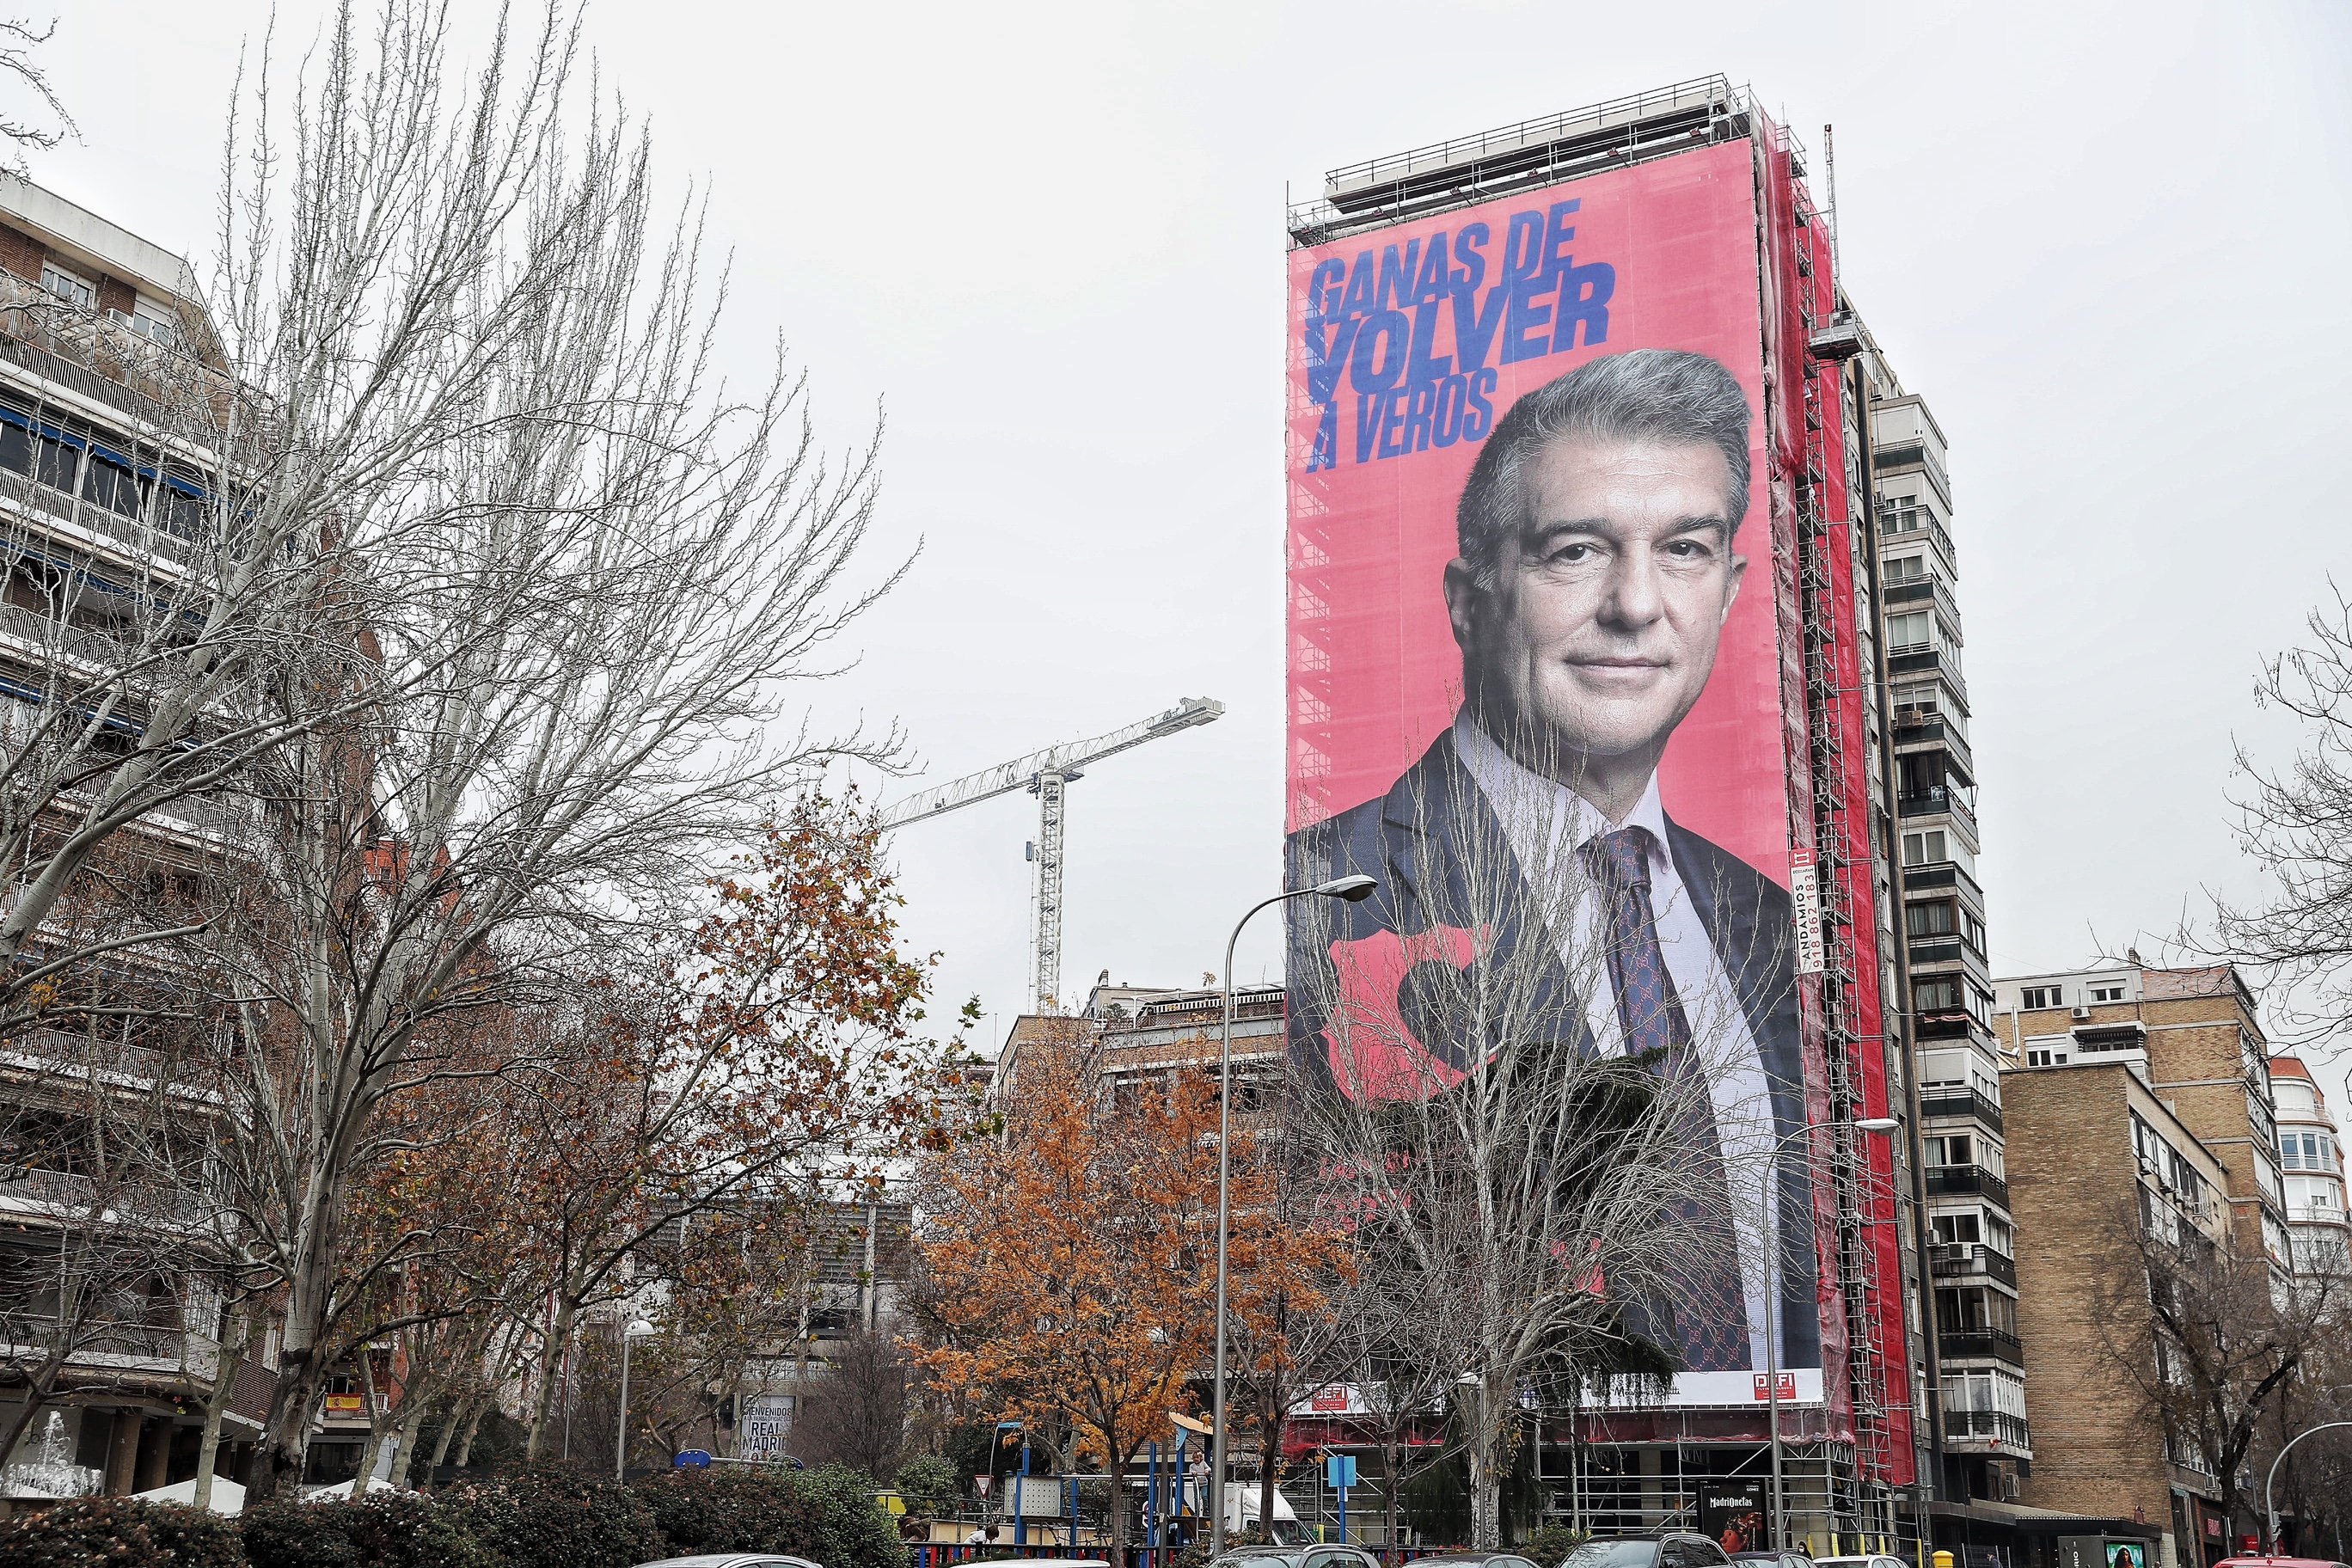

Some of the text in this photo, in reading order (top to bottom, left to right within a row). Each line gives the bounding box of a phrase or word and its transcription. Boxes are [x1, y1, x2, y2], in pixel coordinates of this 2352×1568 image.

[1306, 198, 1582, 328] GANAS DE
[1306, 261, 1616, 406] VOLVER
[1306, 367, 1498, 474] A VEROS
[1795, 884, 1811, 960] ANDAMIOS
[1804, 874, 1822, 968] 918 862 183
[1755, 1374, 1793, 1387] DFI
